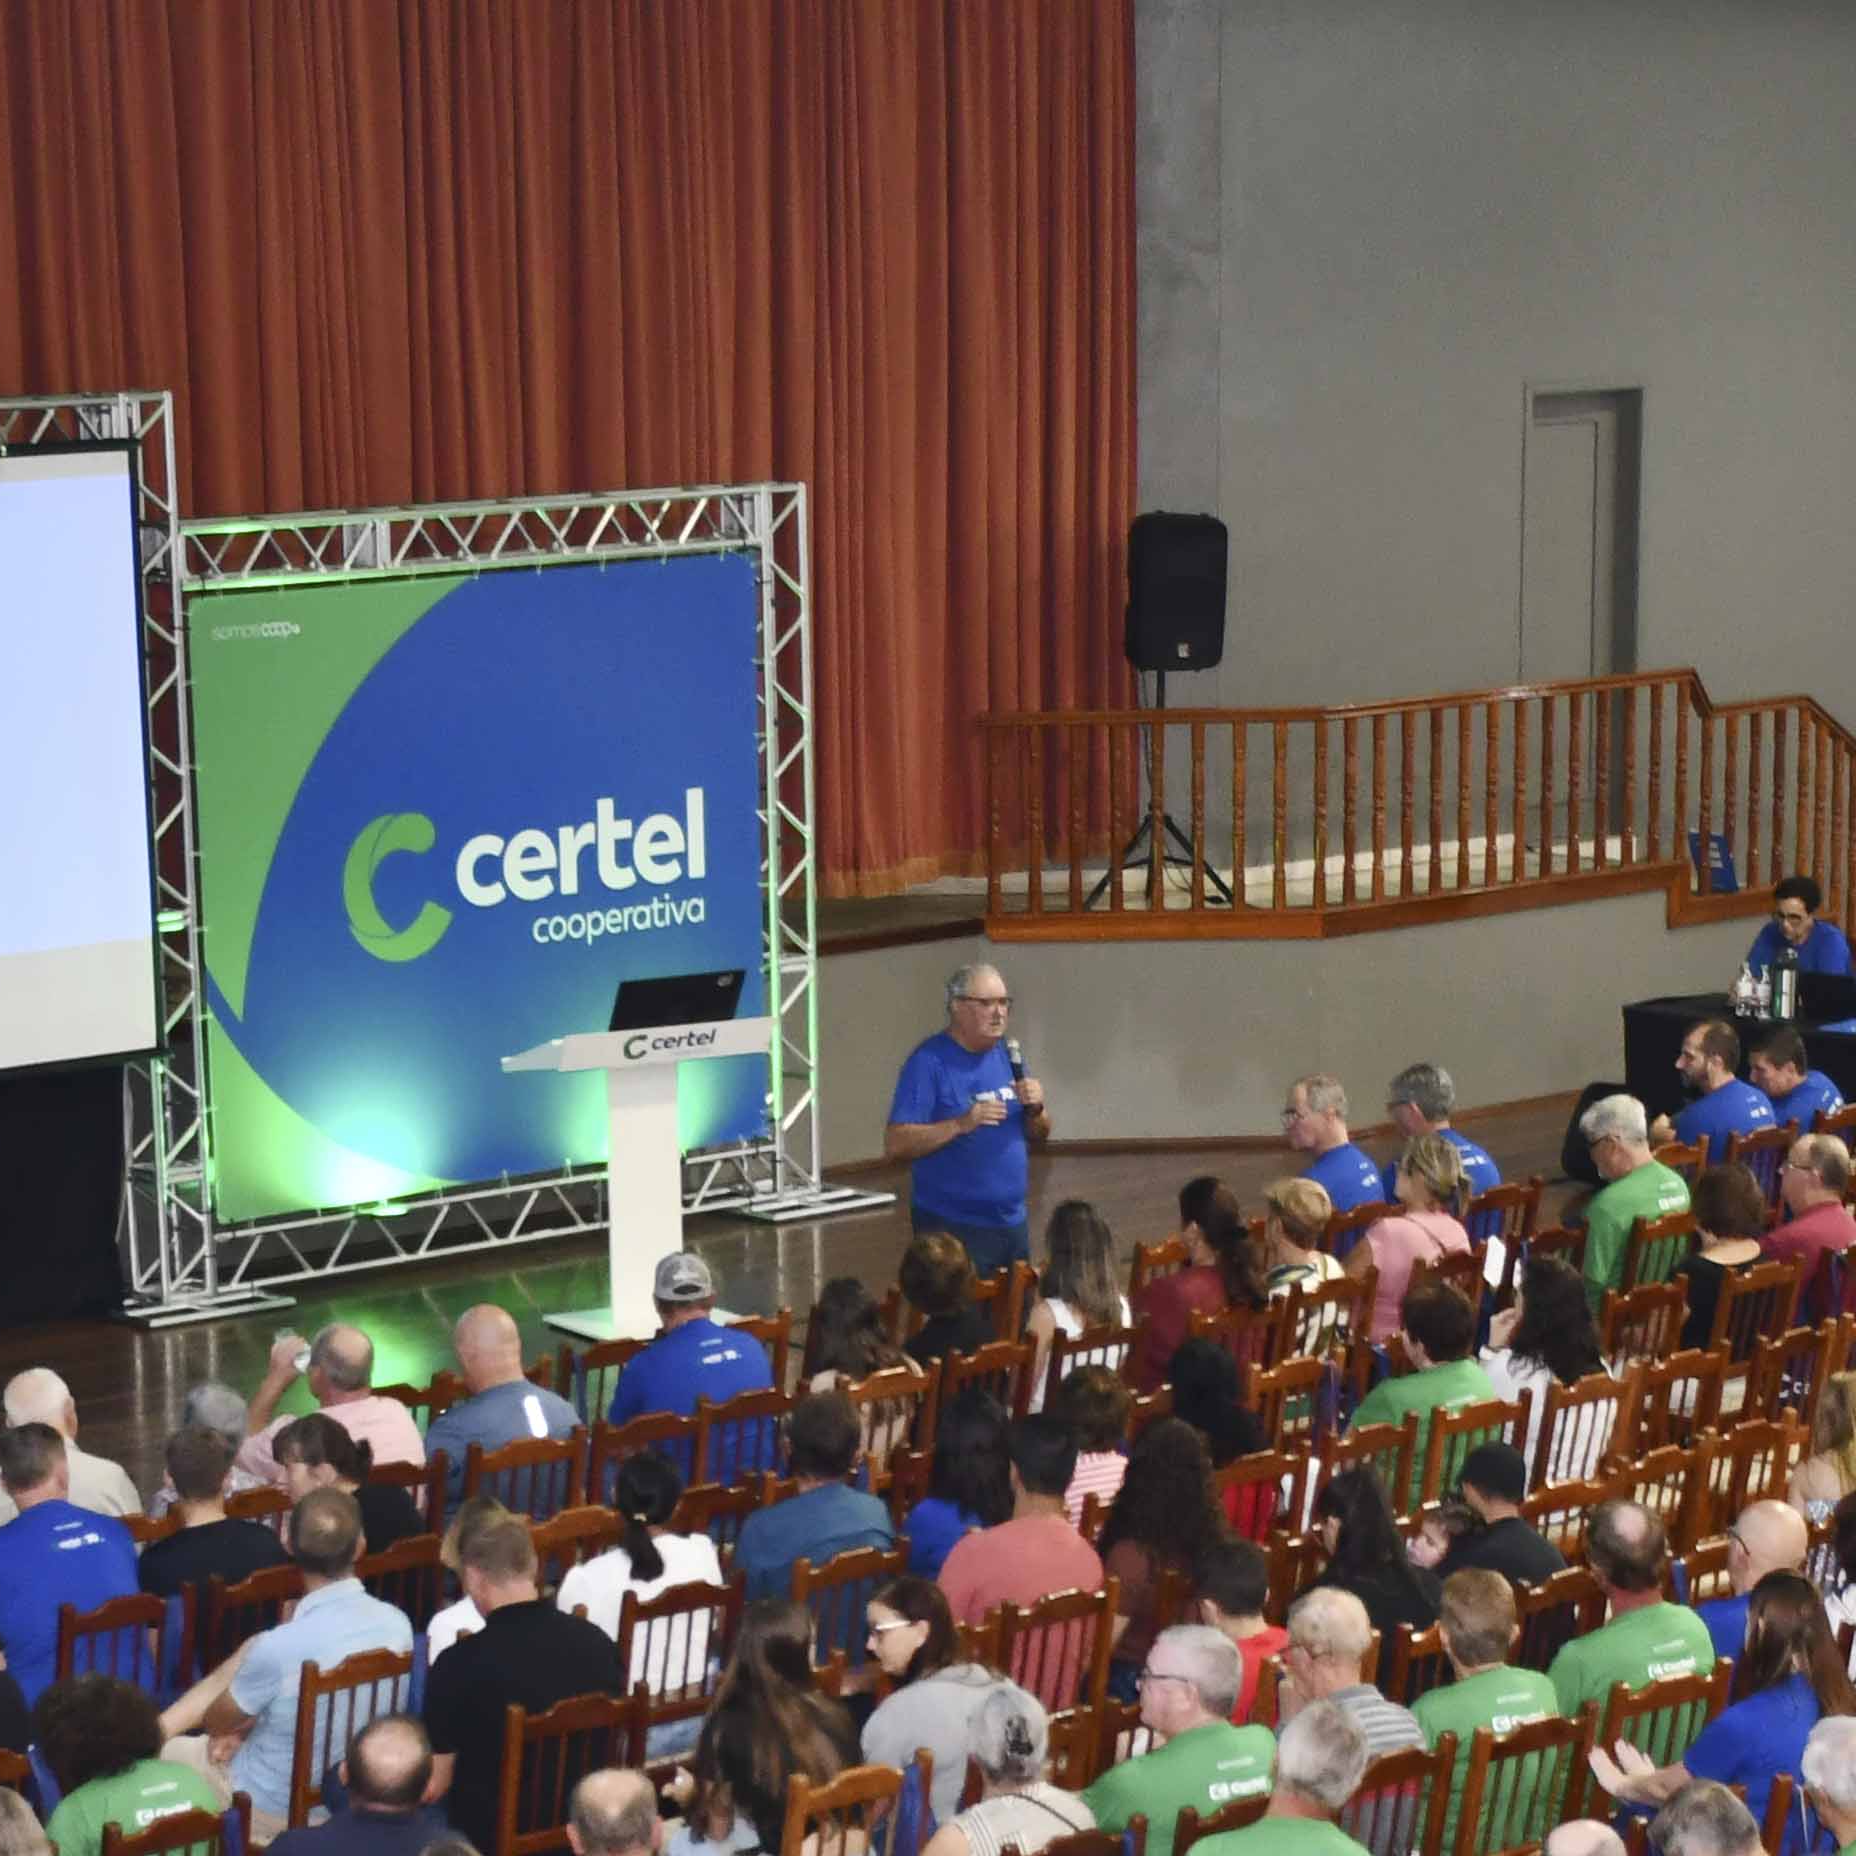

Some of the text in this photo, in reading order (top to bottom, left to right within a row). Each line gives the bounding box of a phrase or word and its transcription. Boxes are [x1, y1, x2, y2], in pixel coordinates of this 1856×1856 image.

[455, 787, 706, 907] certel
[532, 897, 706, 945] cooperativa
[651, 1028, 716, 1051] certel
